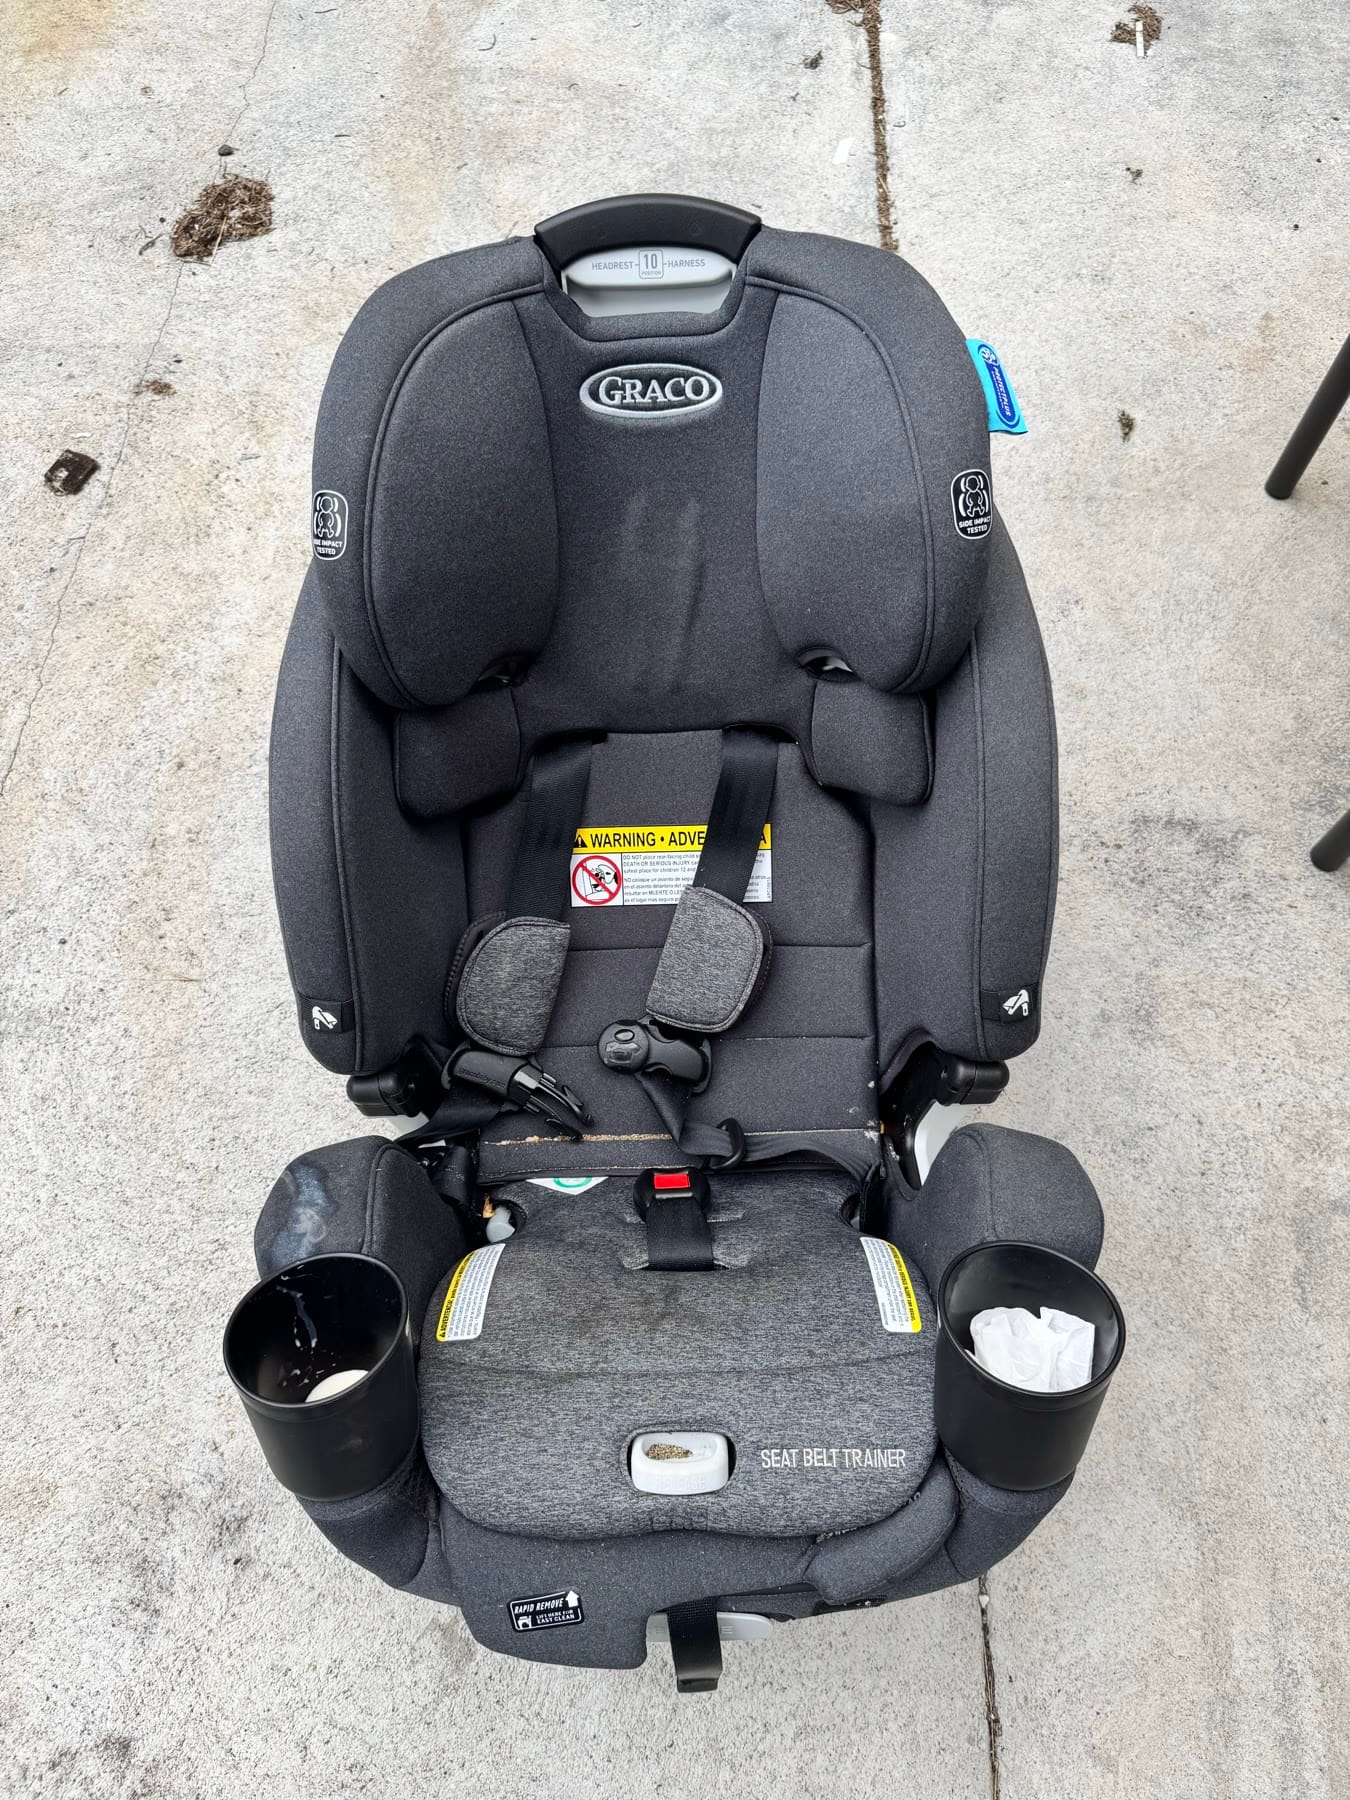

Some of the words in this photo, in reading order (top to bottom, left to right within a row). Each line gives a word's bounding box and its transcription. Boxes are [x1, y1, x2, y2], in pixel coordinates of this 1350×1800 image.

[592, 260, 634, 270] HEADREST
[643, 253, 658, 269] 10
[667, 258, 706, 268] HARNESS
[599, 376, 710, 405] GRACO
[958, 519, 973, 529] SIDE
[966, 525, 988, 534] TESTED
[321, 540, 343, 548] IMPACT
[590, 831, 656, 849] WARNING
[761, 1449, 798, 1468] SEAT
[803, 1448, 839, 1468] BELT
[842, 1449, 906, 1468] TRAINER
[514, 1603, 535, 1614] RAPID
[536, 1598, 564, 1611] REMOVE
[554, 1614, 575, 1622] CLEAN
